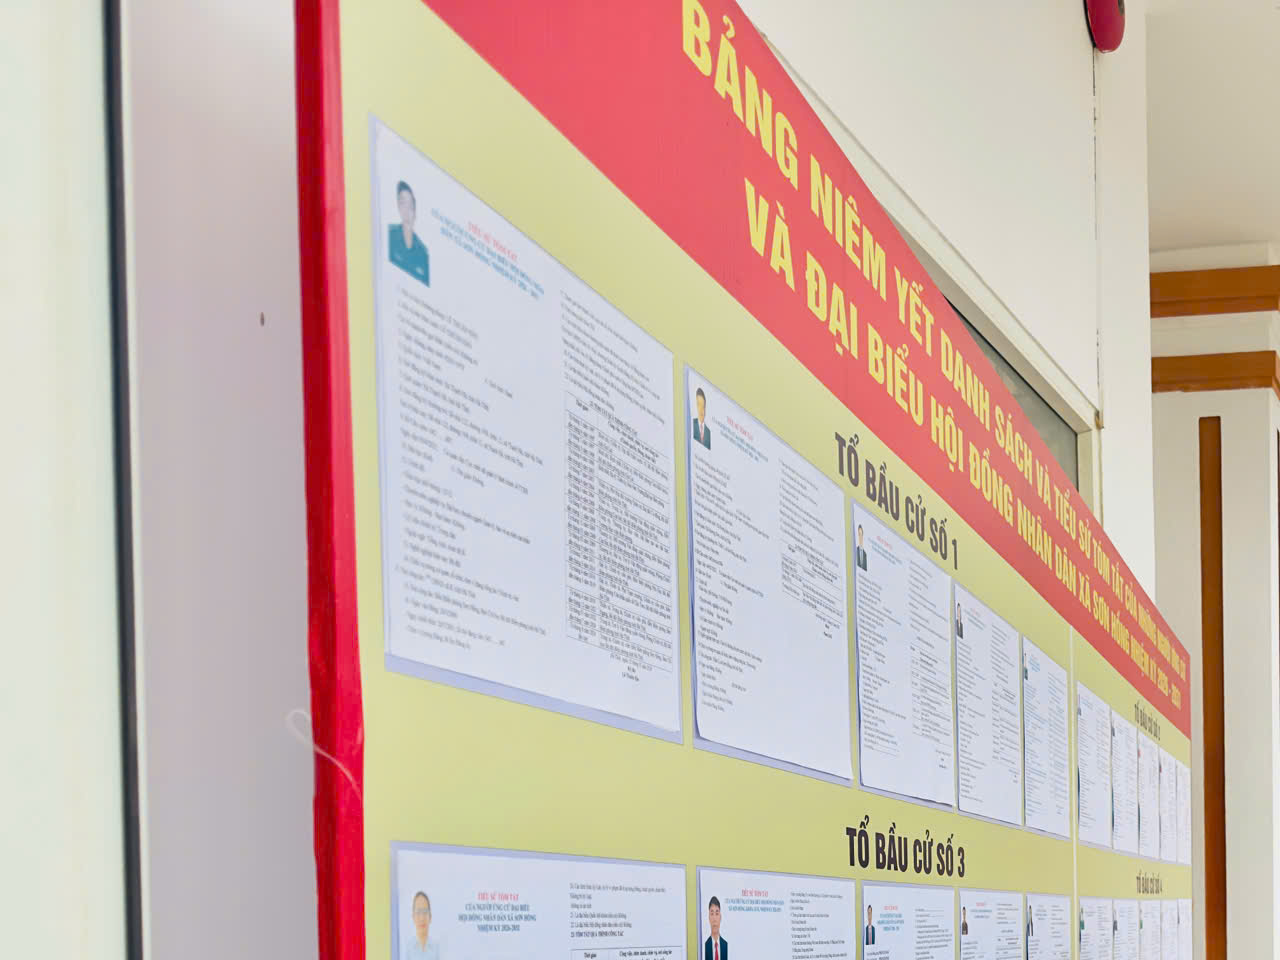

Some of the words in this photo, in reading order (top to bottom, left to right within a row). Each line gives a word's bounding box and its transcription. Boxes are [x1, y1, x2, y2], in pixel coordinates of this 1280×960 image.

[682, 0, 798, 191] BẢNG
[810, 153, 886, 301] NIÊM
[894, 266, 934, 357] YẾT
[940, 328, 990, 431] DANH
[995, 405, 1032, 485] SÁCH
[1036, 459, 1052, 511] VÀ
[1054, 484, 1077, 541] TIỂU
[1079, 518, 1091, 559] SỬ
[1093, 539, 1110, 586] TÓM
[744, 177, 795, 292] VÀ
[805, 250, 858, 360] ĐẠI
[867, 323, 924, 426] BIỂU
[930, 395, 963, 473] HỘI
[969, 441, 1014, 527] ĐỒNG
[1017, 498, 1052, 570] NHÂN
[1055, 545, 1077, 596] DÂN
[1079, 571, 1091, 613] XÃ
[1093, 590, 1110, 633] SƠN
[835, 431, 859, 487] TỔ
[865, 459, 900, 521] BẦU
[905, 494, 926, 542] CỬ
[930, 517, 947, 561] SỐ
[952, 538, 958, 570] 1
[846, 815, 869, 869] TỔ
[875, 822, 908, 872] BẦU
[913, 829, 933, 875] CỬ
[937, 833, 954, 877] SỐ
[958, 846, 965, 878] 3
